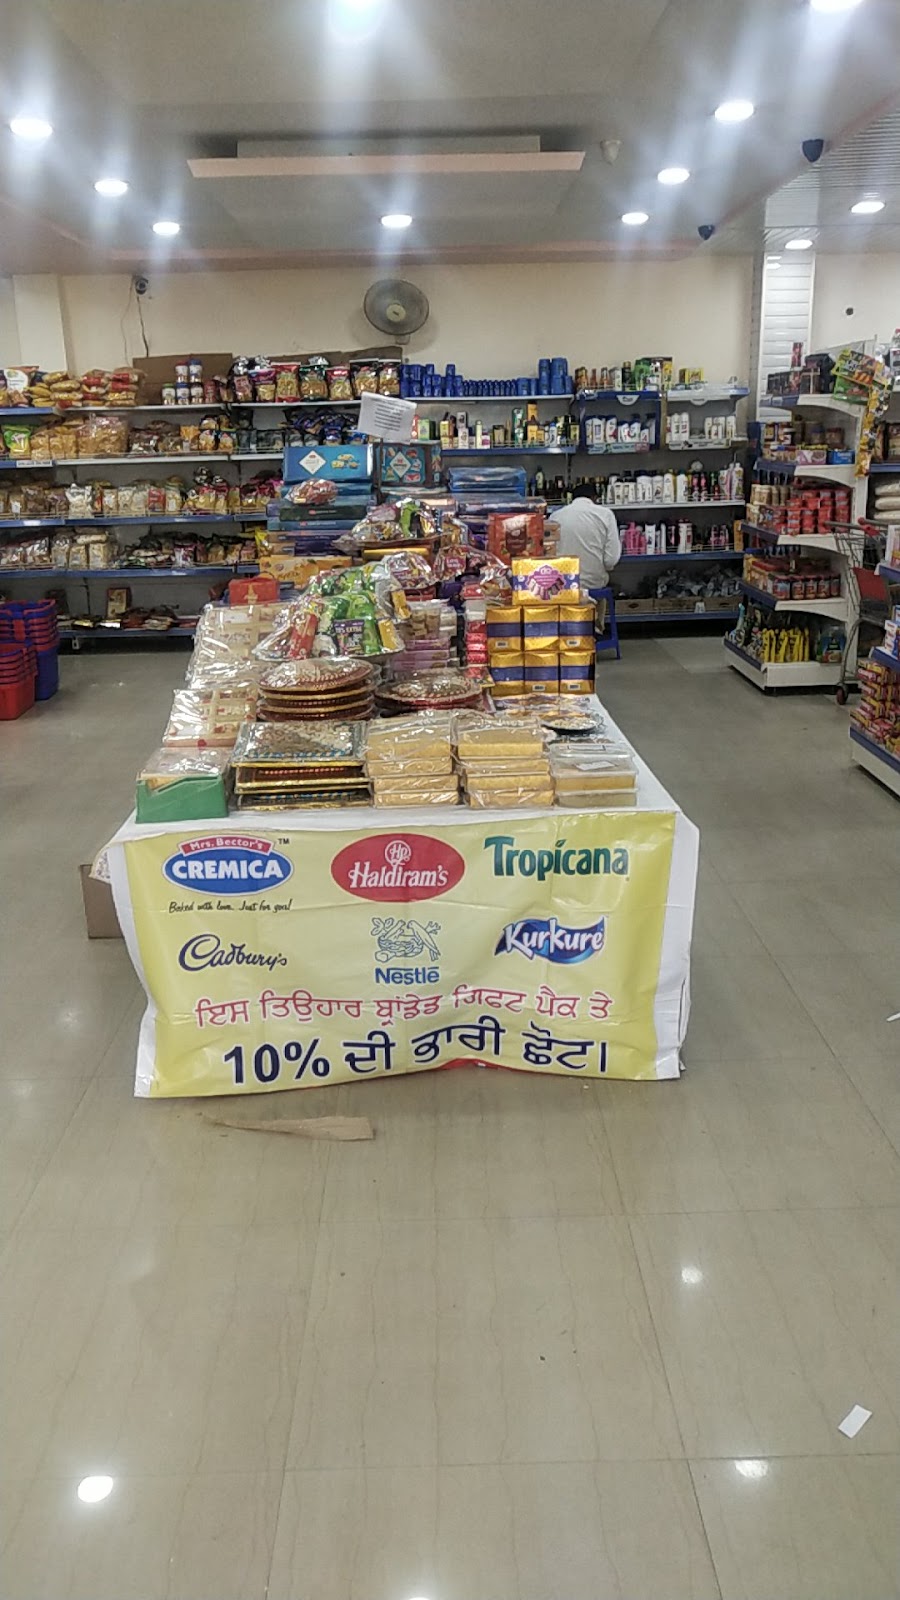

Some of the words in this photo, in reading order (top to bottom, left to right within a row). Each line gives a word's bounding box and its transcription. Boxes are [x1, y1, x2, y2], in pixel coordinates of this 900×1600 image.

[190, 841, 214, 851] Mrs.
[216, 838, 263, 850] Bector's
[484, 836, 629, 881] Tropicana
[172, 859, 284, 879] CREMICA
[348, 861, 449, 888] Haldiram's
[169, 901, 194, 913] Baked
[197, 901, 213, 911] with
[239, 900, 258, 911] Just
[259, 900, 271, 911] for
[272, 898, 293, 913] you!
[179, 934, 288, 971] Cadbury's
[505, 918, 605, 960] Kurkure
[195, 998, 249, 1027] ਇਸ
[259, 989, 363, 1021] ਤਿਉਹਾਰ
[373, 993, 443, 1027] ਬ੍ਰਾਂਡੇਡ
[536, 985, 580, 1018] ਪੈਕ
[590, 991, 612, 1019] ਤੇ
[224, 1038, 330, 1084] 10%
[343, 1030, 395, 1074] ਦੀ
[411, 1015, 506, 1063] ਭਾਰੀ
